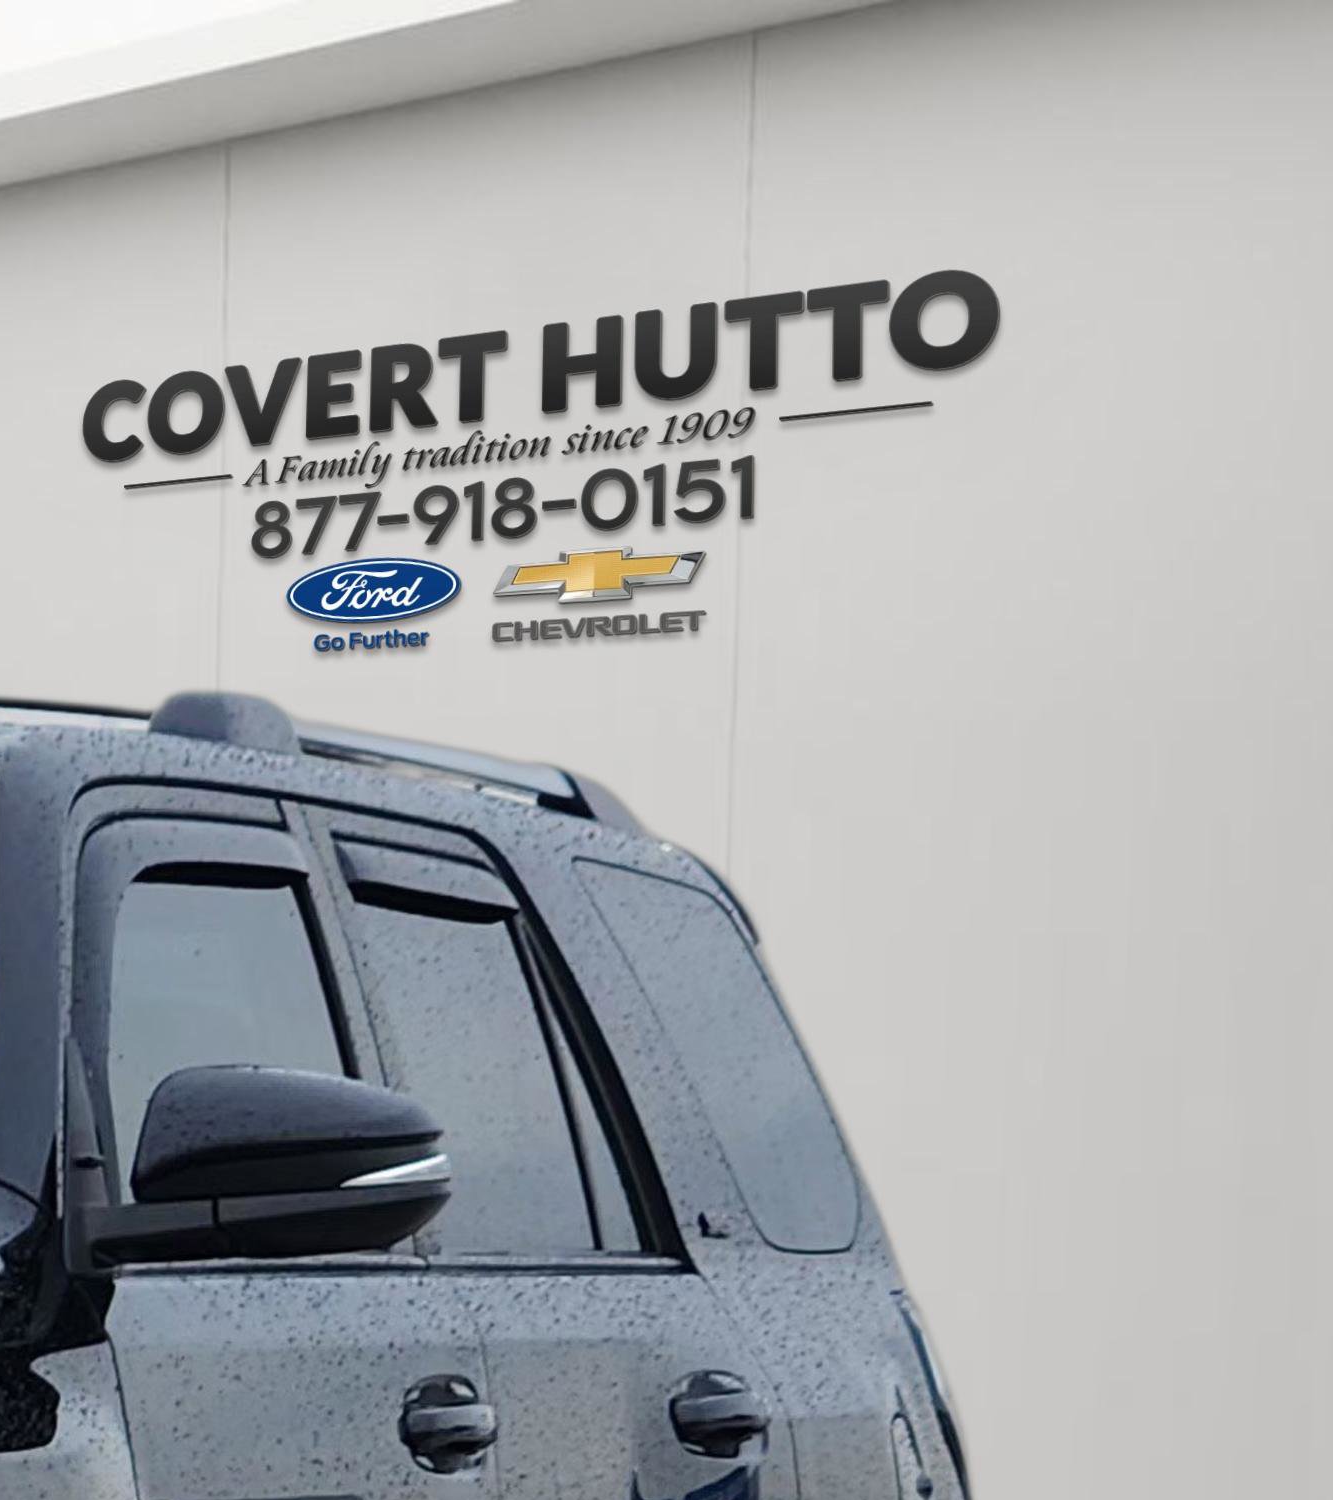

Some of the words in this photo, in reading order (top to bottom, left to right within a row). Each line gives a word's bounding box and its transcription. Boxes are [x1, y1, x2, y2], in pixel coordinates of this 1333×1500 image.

[82, 330, 509, 465] COVERT
[541, 269, 1001, 416] HUTTO
[242, 457, 270, 488] A
[274, 440, 393, 490] Family
[402, 429, 553, 472] tradition
[561, 424, 650, 455] since
[656, 406, 756, 447] 1909
[250, 454, 755, 560] 877-918-0151
[321, 570, 422, 611] Ford
[313, 632, 346, 653] Go
[348, 628, 430, 651] Further
[491, 610, 707, 643] CHEVROLET
